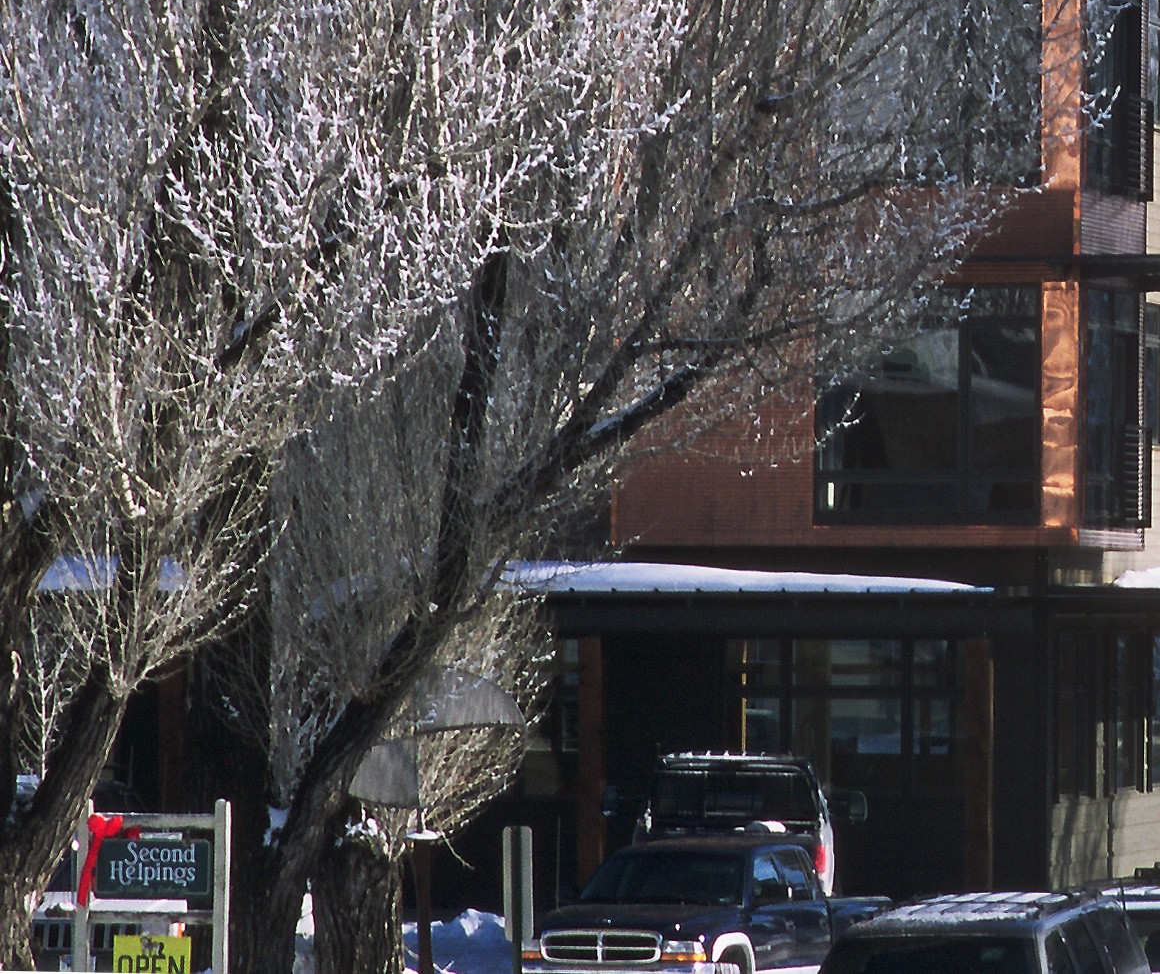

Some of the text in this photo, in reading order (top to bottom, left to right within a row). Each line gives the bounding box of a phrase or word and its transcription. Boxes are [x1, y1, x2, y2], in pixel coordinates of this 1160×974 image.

[125, 841, 195, 866] Second
[110, 860, 196, 887] Helpings
[117, 954, 186, 973] OPEN
